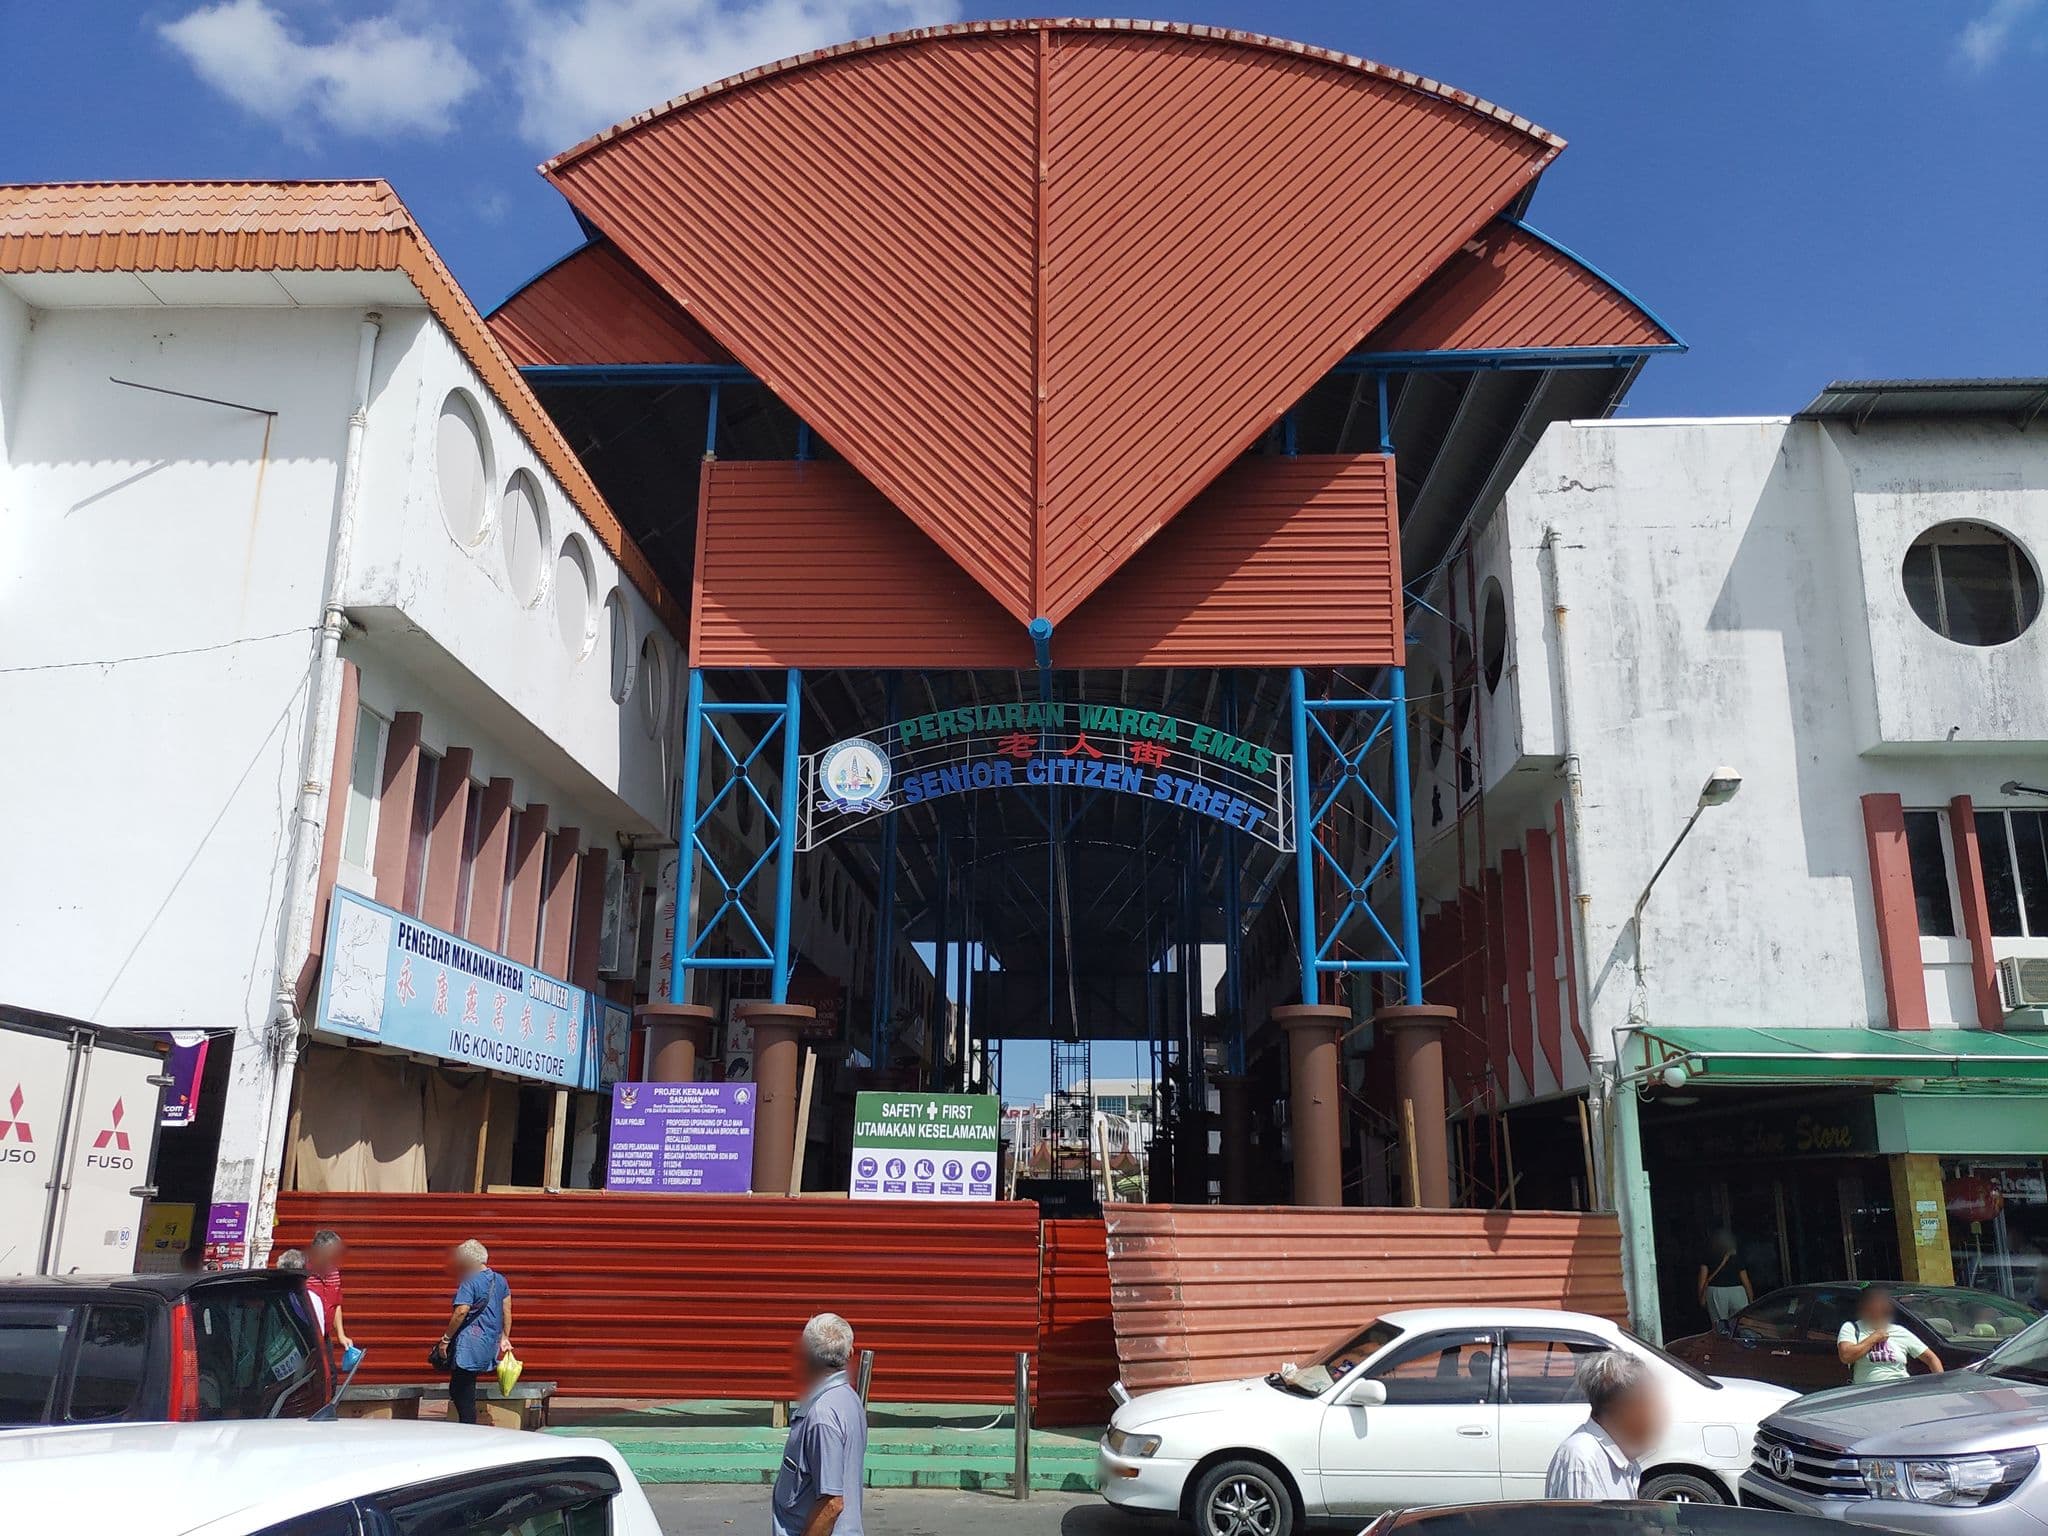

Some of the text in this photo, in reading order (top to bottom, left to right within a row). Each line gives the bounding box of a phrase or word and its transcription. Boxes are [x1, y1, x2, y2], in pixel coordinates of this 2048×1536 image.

[899, 702, 1272, 774] PERSIARAN WARGA EMAS
[997, 732, 1171, 769] 老人街
[903, 758, 1267, 833] SENIOR CITIZEN STREET
[397, 922, 451, 966] PENGEDAR
[451, 943, 496, 983] MAKANAN
[495, 962, 524, 993] HERBA
[529, 973, 552, 1005] SNOW
[551, 980, 569, 1011] DEER
[450, 1029, 565, 1077] ING KONG DRUG STORE
[654, 1088, 720, 1096] PROJEK KERAJAAN
[669, 1096, 703, 1104] SARAWAK
[882, 1102, 973, 1120] SAFETY FIRST
[628, 1118, 646, 1126] PROJEK
[666, 1119, 690, 1127] PROPOSED
[690, 1119, 716, 1127] UPGRADING
[716, 1119, 722, 1127] OF
[722, 1119, 733, 1127] OLD
[732, 1119, 743, 1127] MAN
[665, 1127, 682, 1135] STREET
[705, 1127, 719, 1135] JALAN
[856, 1121, 996, 1140] UTAMAKAN KESELAMATAN
[1796, 1114, 1853, 1150] Store
[664, 1143, 681, 1151] MAJLIS
[680, 1143, 707, 1151] BANDARAYA
[665, 1135, 691, 1144] (RECALLED)
[0, 1149, 36, 1164] USO
[87, 1155, 134, 1170] FUSO
[685, 1152, 718, 1160] CONSTRUCTION
[719, 1152, 729, 1160] SDN
[728, 1152, 739, 1160] BHD
[638, 1168, 656, 1176] PROJEK
[668, 1169, 693, 1177] NOVEMBER
[635, 1176, 653, 1184] PROJEK
[667, 1177, 691, 1185] FEBRUARY
